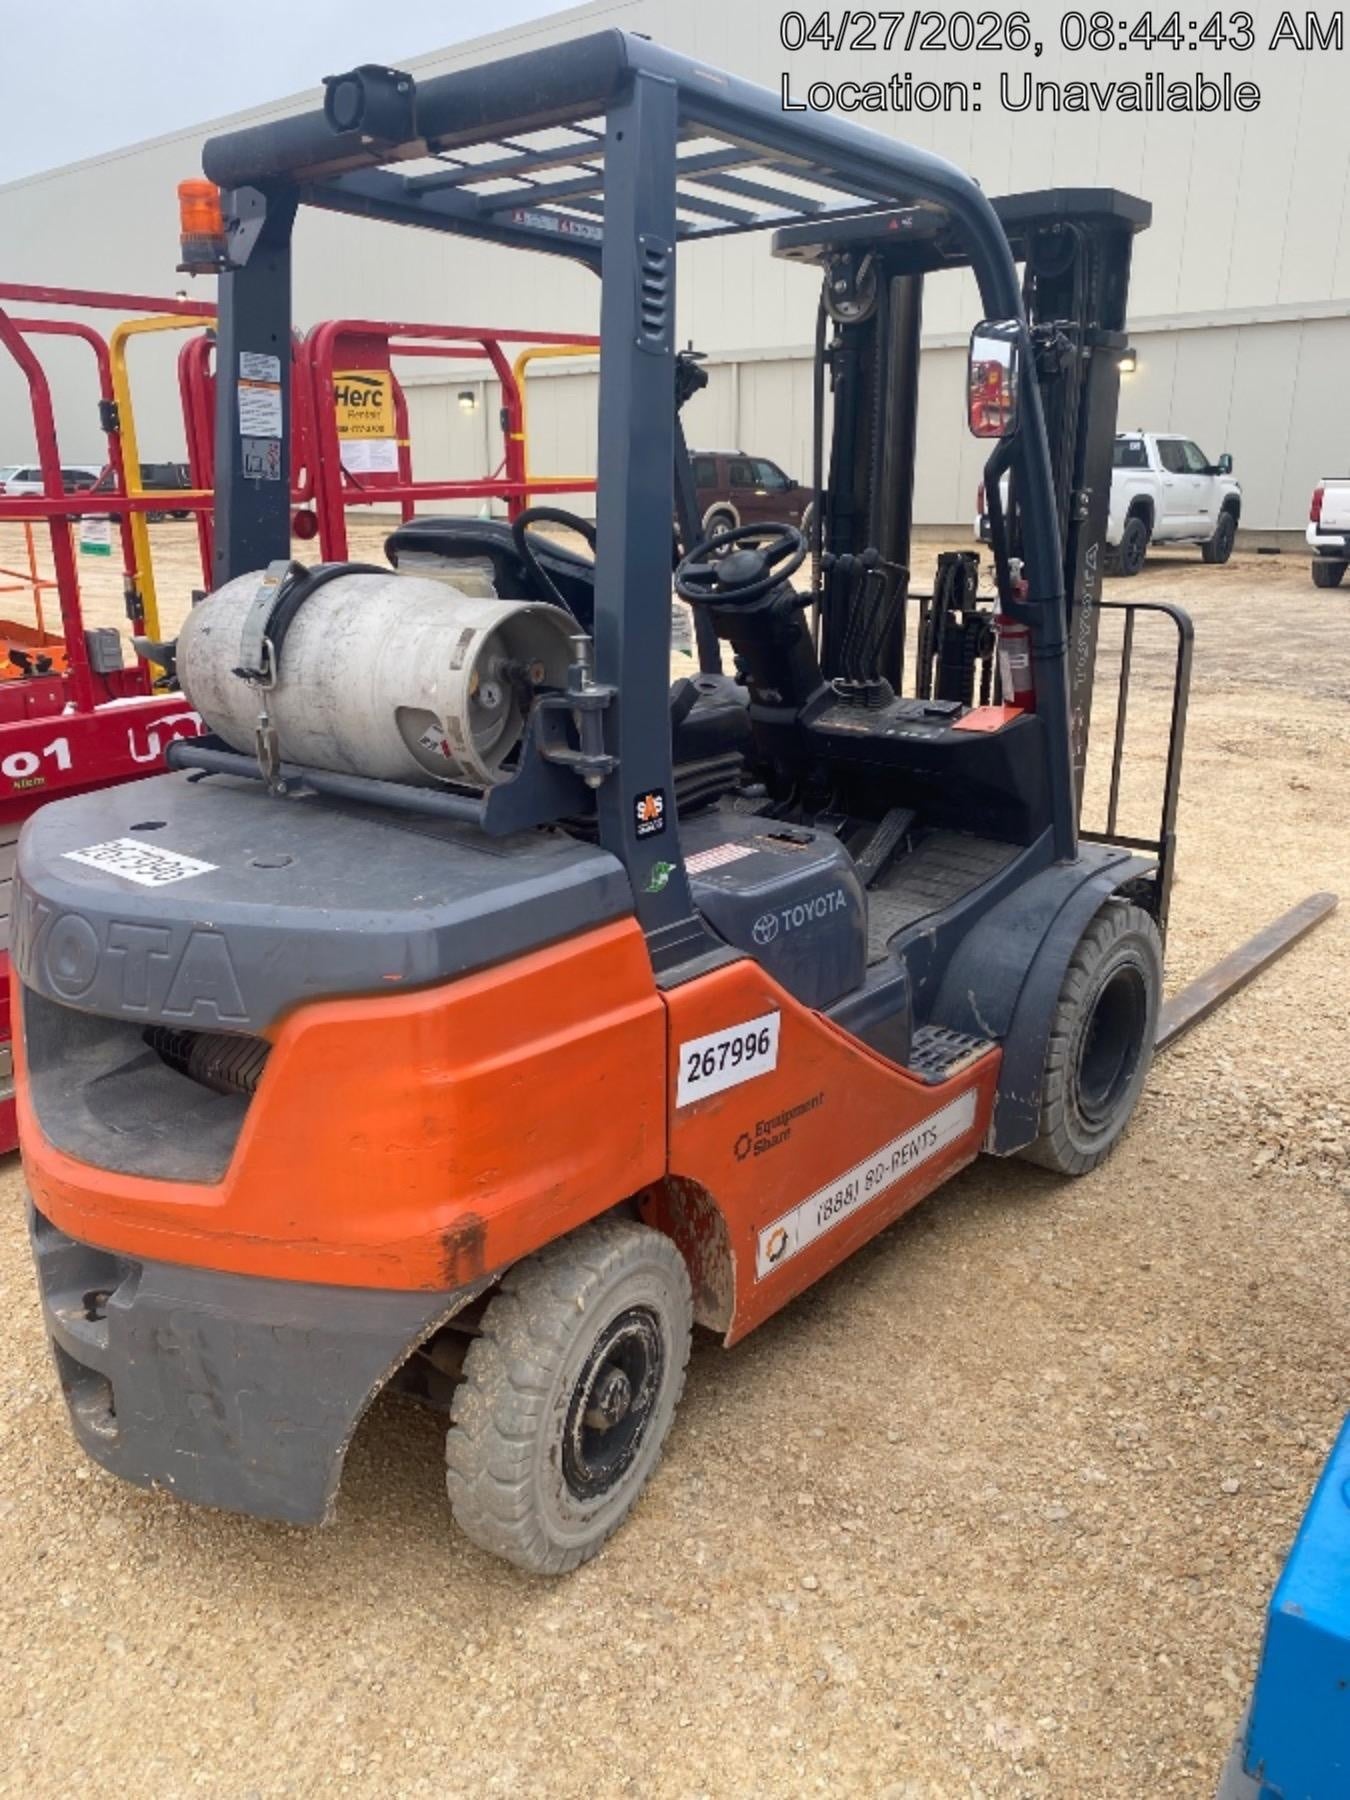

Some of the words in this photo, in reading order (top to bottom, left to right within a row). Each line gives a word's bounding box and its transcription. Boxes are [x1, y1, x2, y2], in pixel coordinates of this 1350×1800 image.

[334, 385, 383, 407] Herc
[781, 888, 847, 931] TOYOTA
[687, 1027, 770, 1082] 267996
[755, 1091, 824, 1137] Equipment
[816, 1178, 860, 1227] (888)
